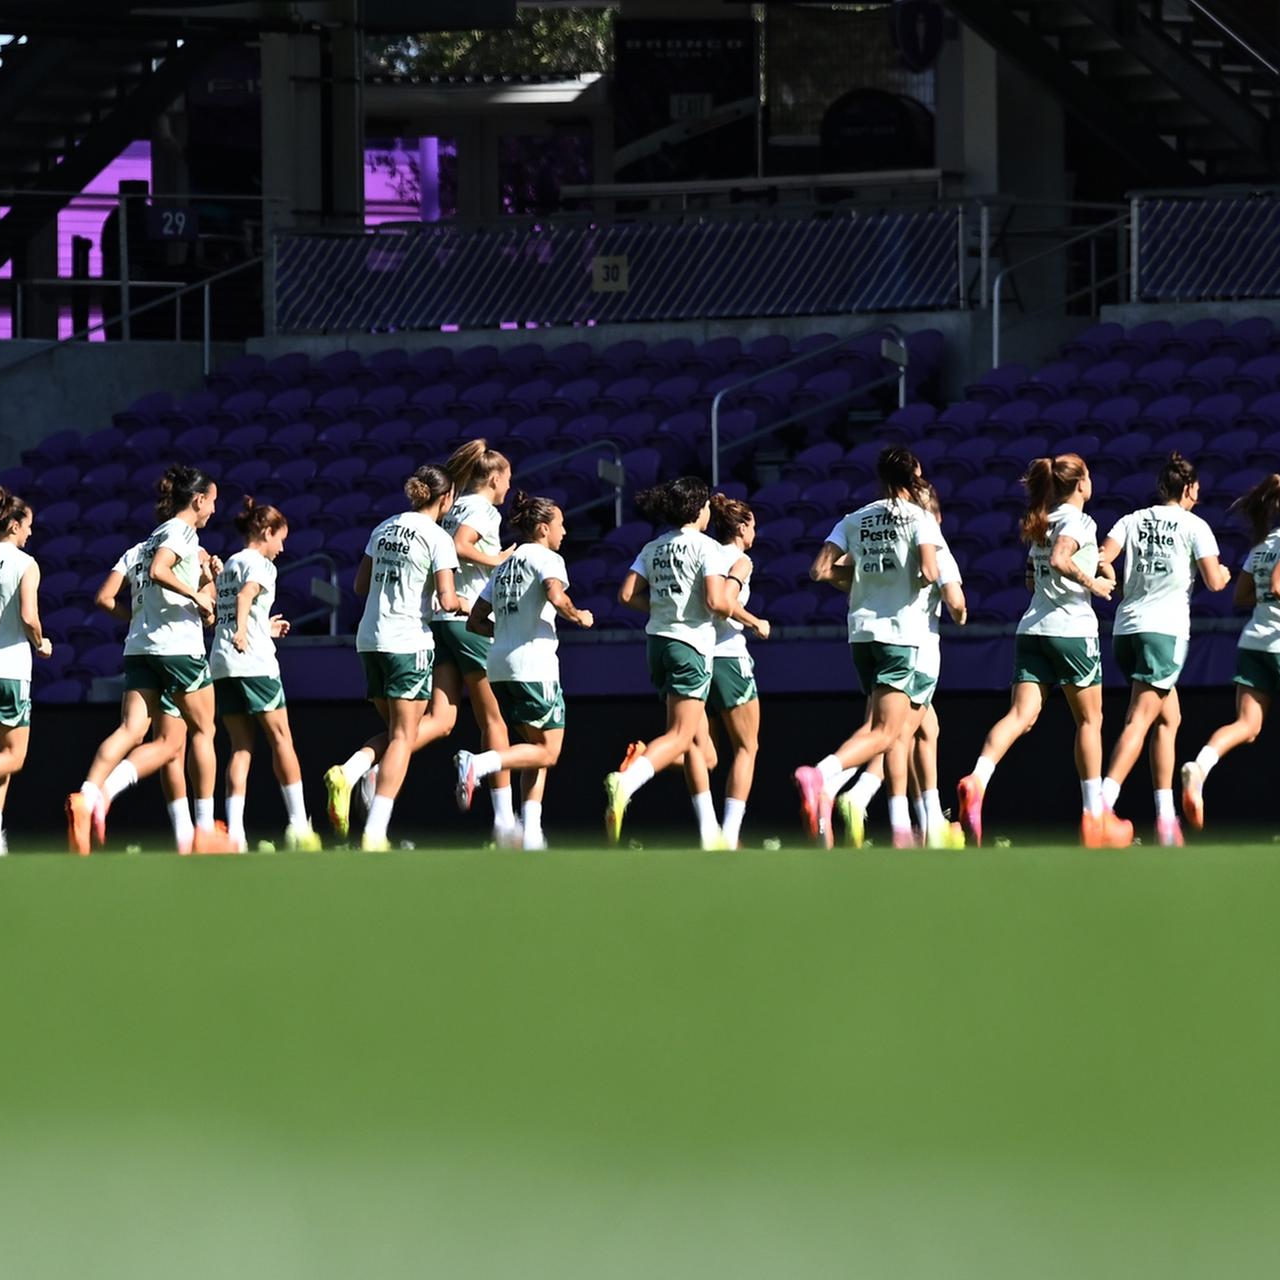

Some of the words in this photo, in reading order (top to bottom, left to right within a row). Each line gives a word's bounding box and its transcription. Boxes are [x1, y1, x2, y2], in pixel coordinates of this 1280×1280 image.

[162, 211, 186, 236] 29
[602, 264, 620, 282] 30
[394, 525, 416, 540] TIM
[1153, 519, 1178, 532] TIM
[861, 529, 897, 542] Poste
[1139, 531, 1174, 546] Poste
[377, 537, 410, 554] Poste
